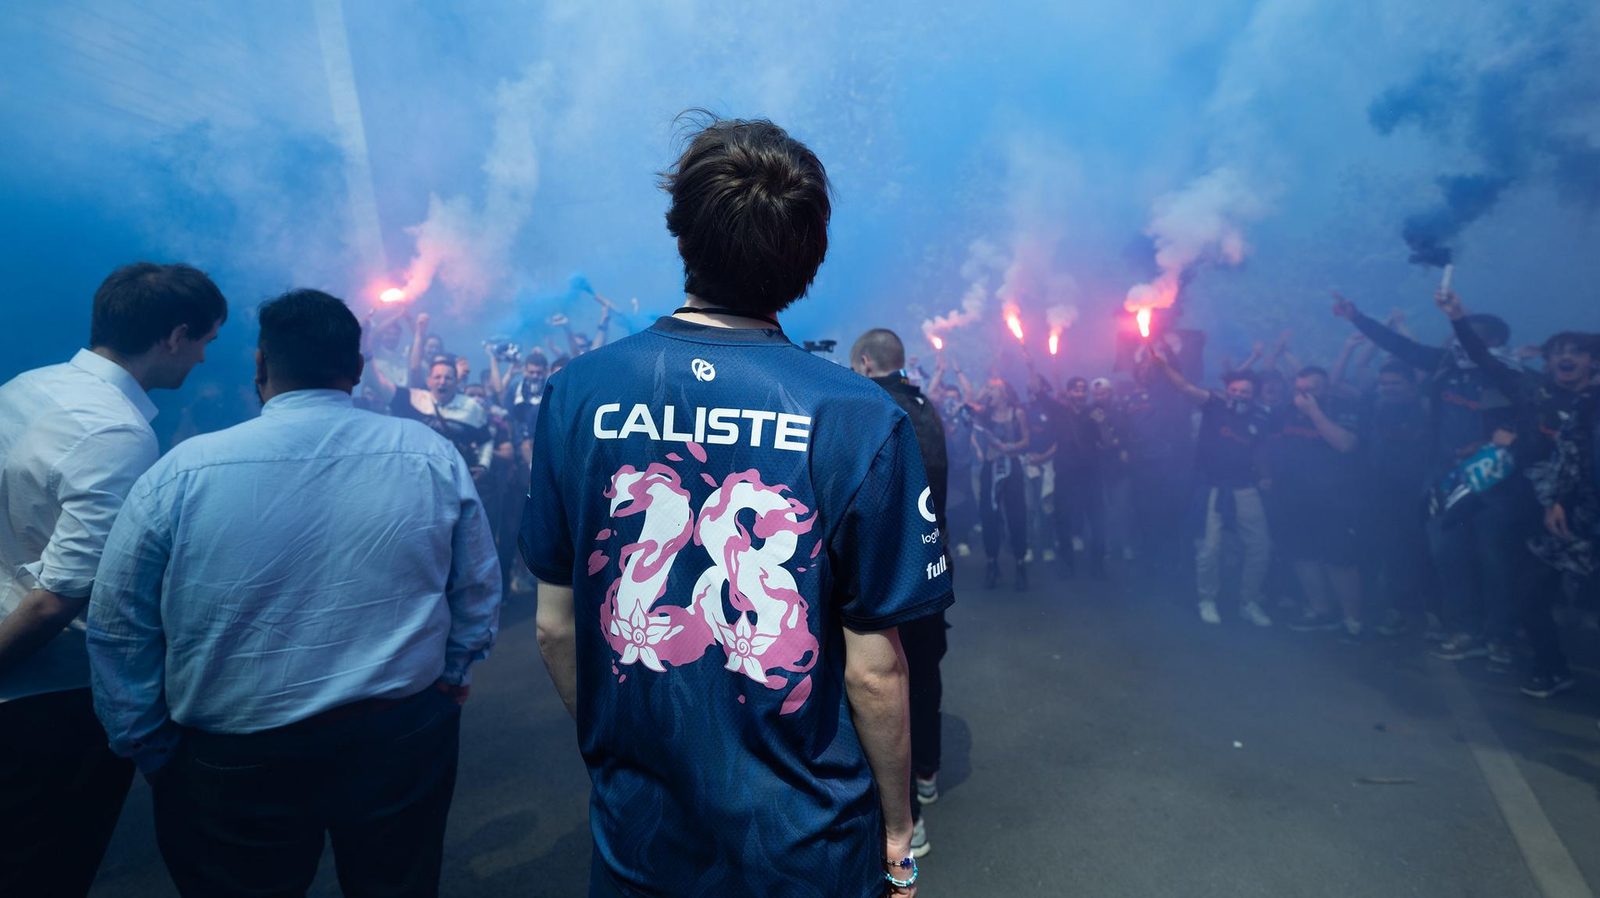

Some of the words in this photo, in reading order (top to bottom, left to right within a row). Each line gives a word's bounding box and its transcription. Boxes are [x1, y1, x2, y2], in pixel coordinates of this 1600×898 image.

[593, 403, 811, 451] CALISTE
[602, 463, 819, 682] 28
[926, 554, 947, 580] full
